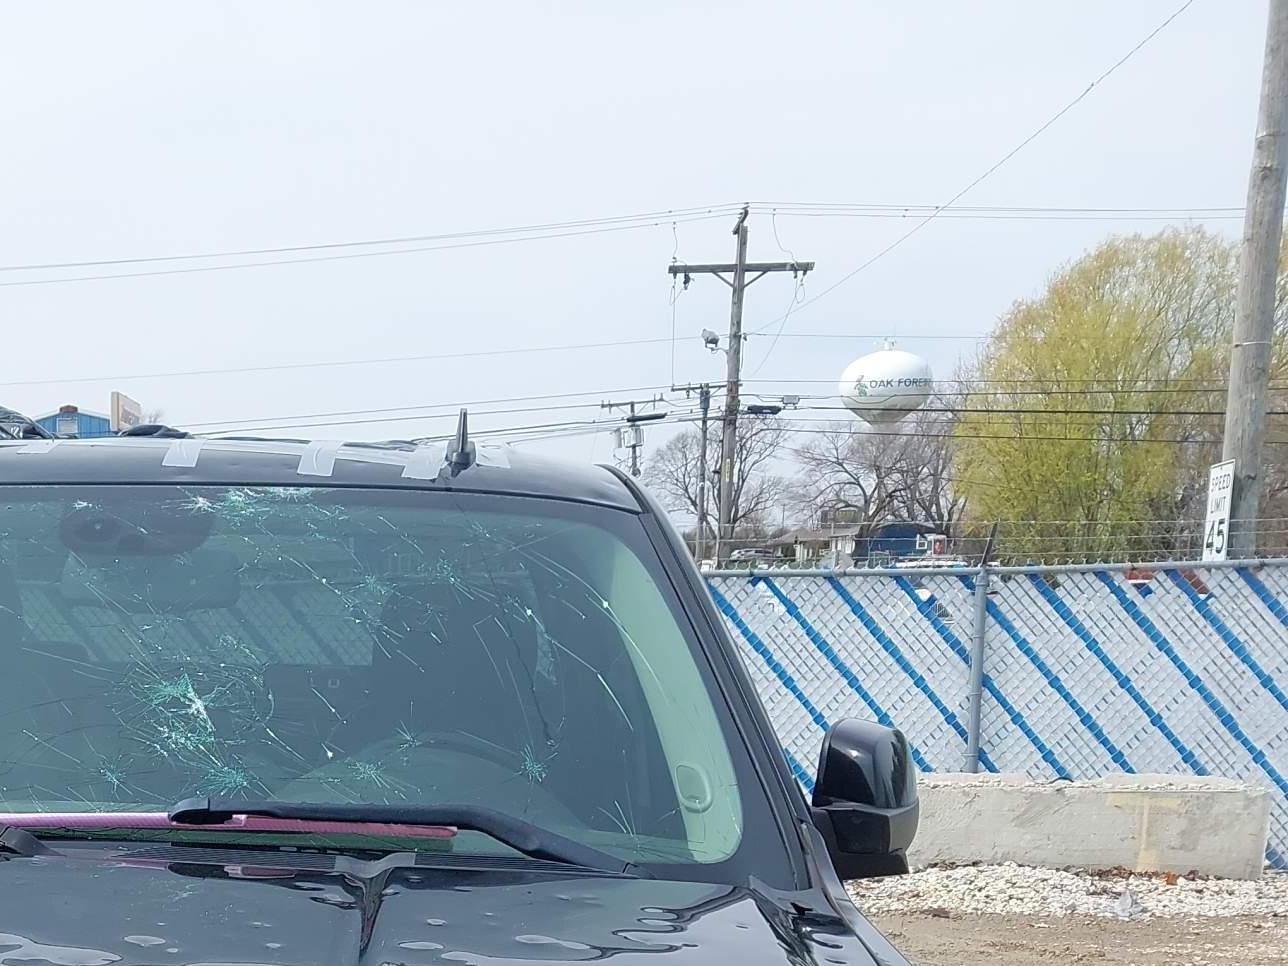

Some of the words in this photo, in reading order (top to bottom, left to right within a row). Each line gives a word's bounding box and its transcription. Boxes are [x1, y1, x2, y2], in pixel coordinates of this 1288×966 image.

[869, 379, 893, 388] OAK
[1211, 473, 1230, 492] SPEED
[1210, 496, 1226, 514] LIMIT
[1205, 519, 1226, 554] 45
